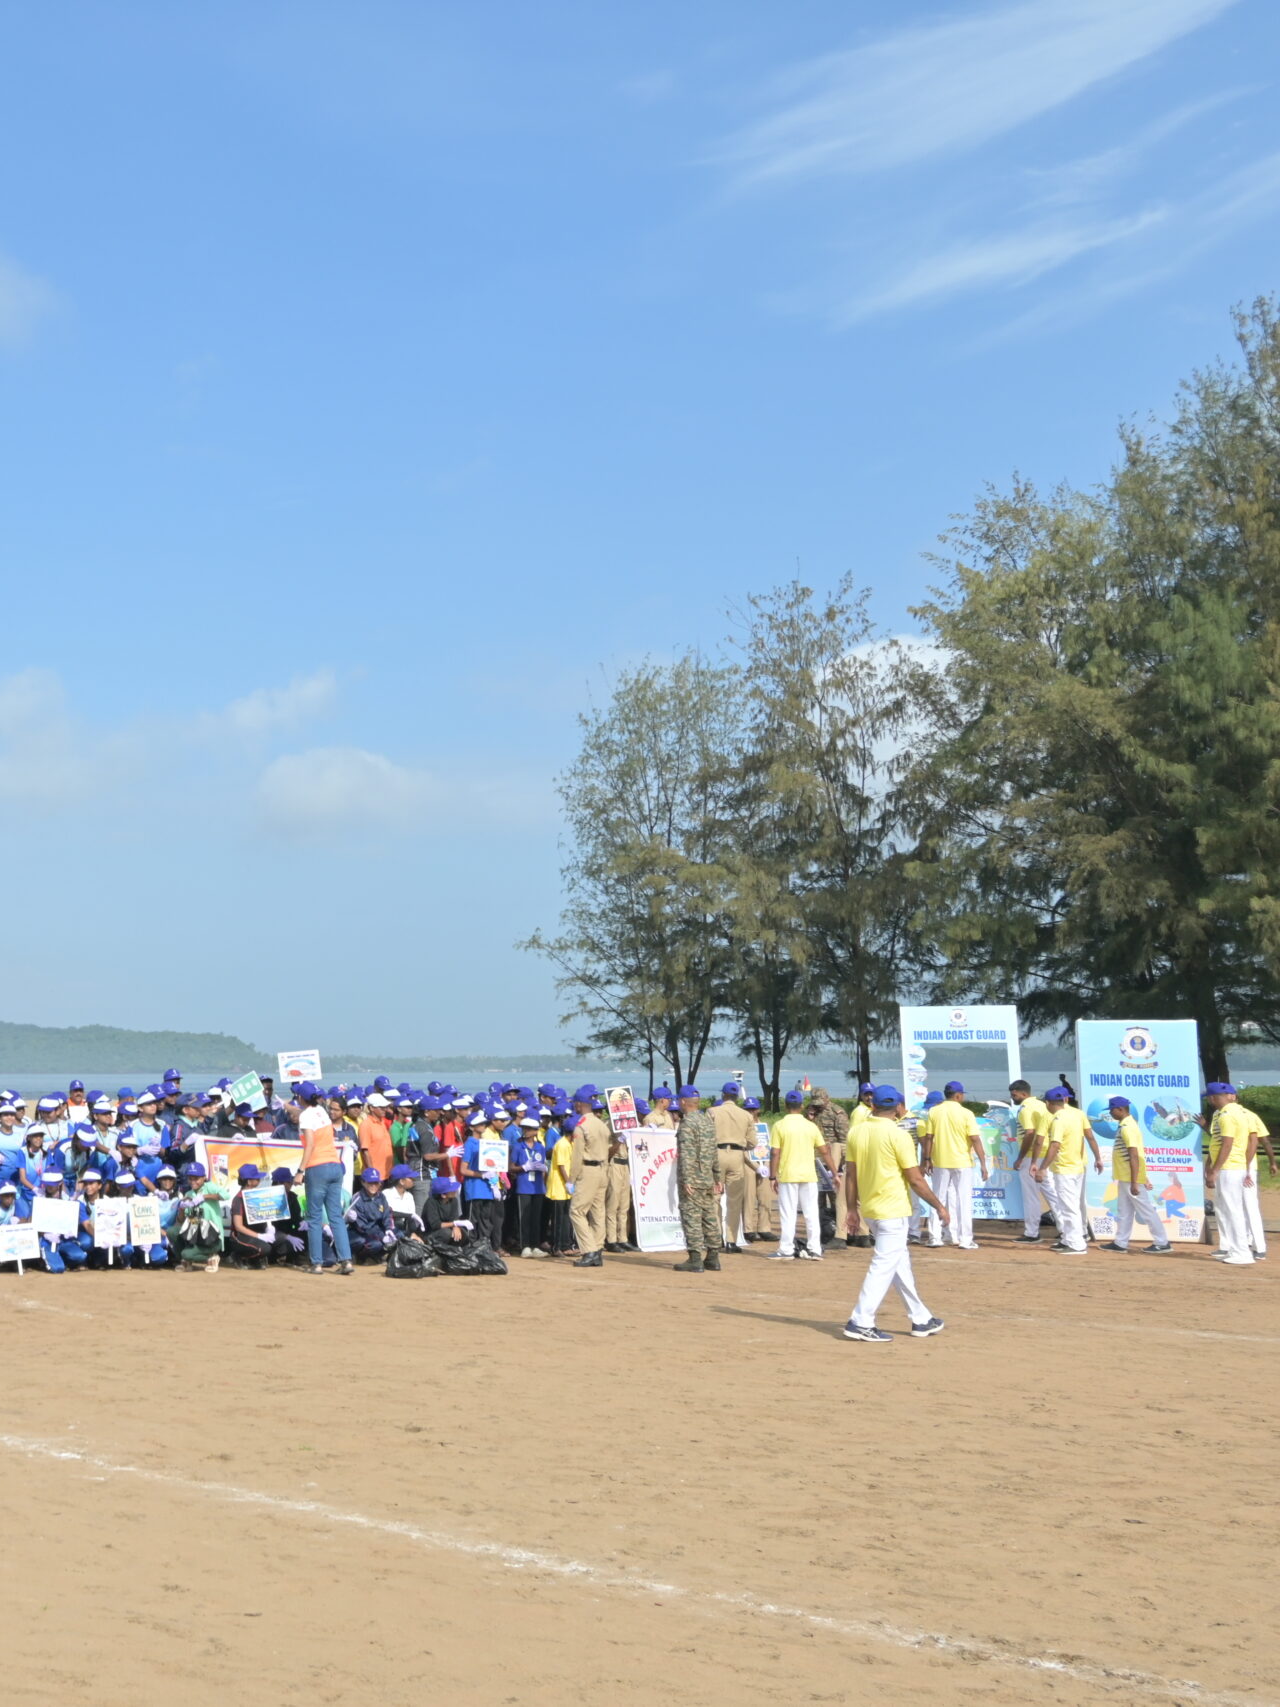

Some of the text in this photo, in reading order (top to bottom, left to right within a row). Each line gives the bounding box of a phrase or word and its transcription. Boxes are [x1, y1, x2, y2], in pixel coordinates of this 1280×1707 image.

[913, 1029, 1006, 1040] INDIAN COAST GUARD
[1090, 1073, 1190, 1088] INDIAN COAST GUARD
[1157, 1156, 1192, 1164] CLEANUP
[640, 1168, 656, 1196] GOA
